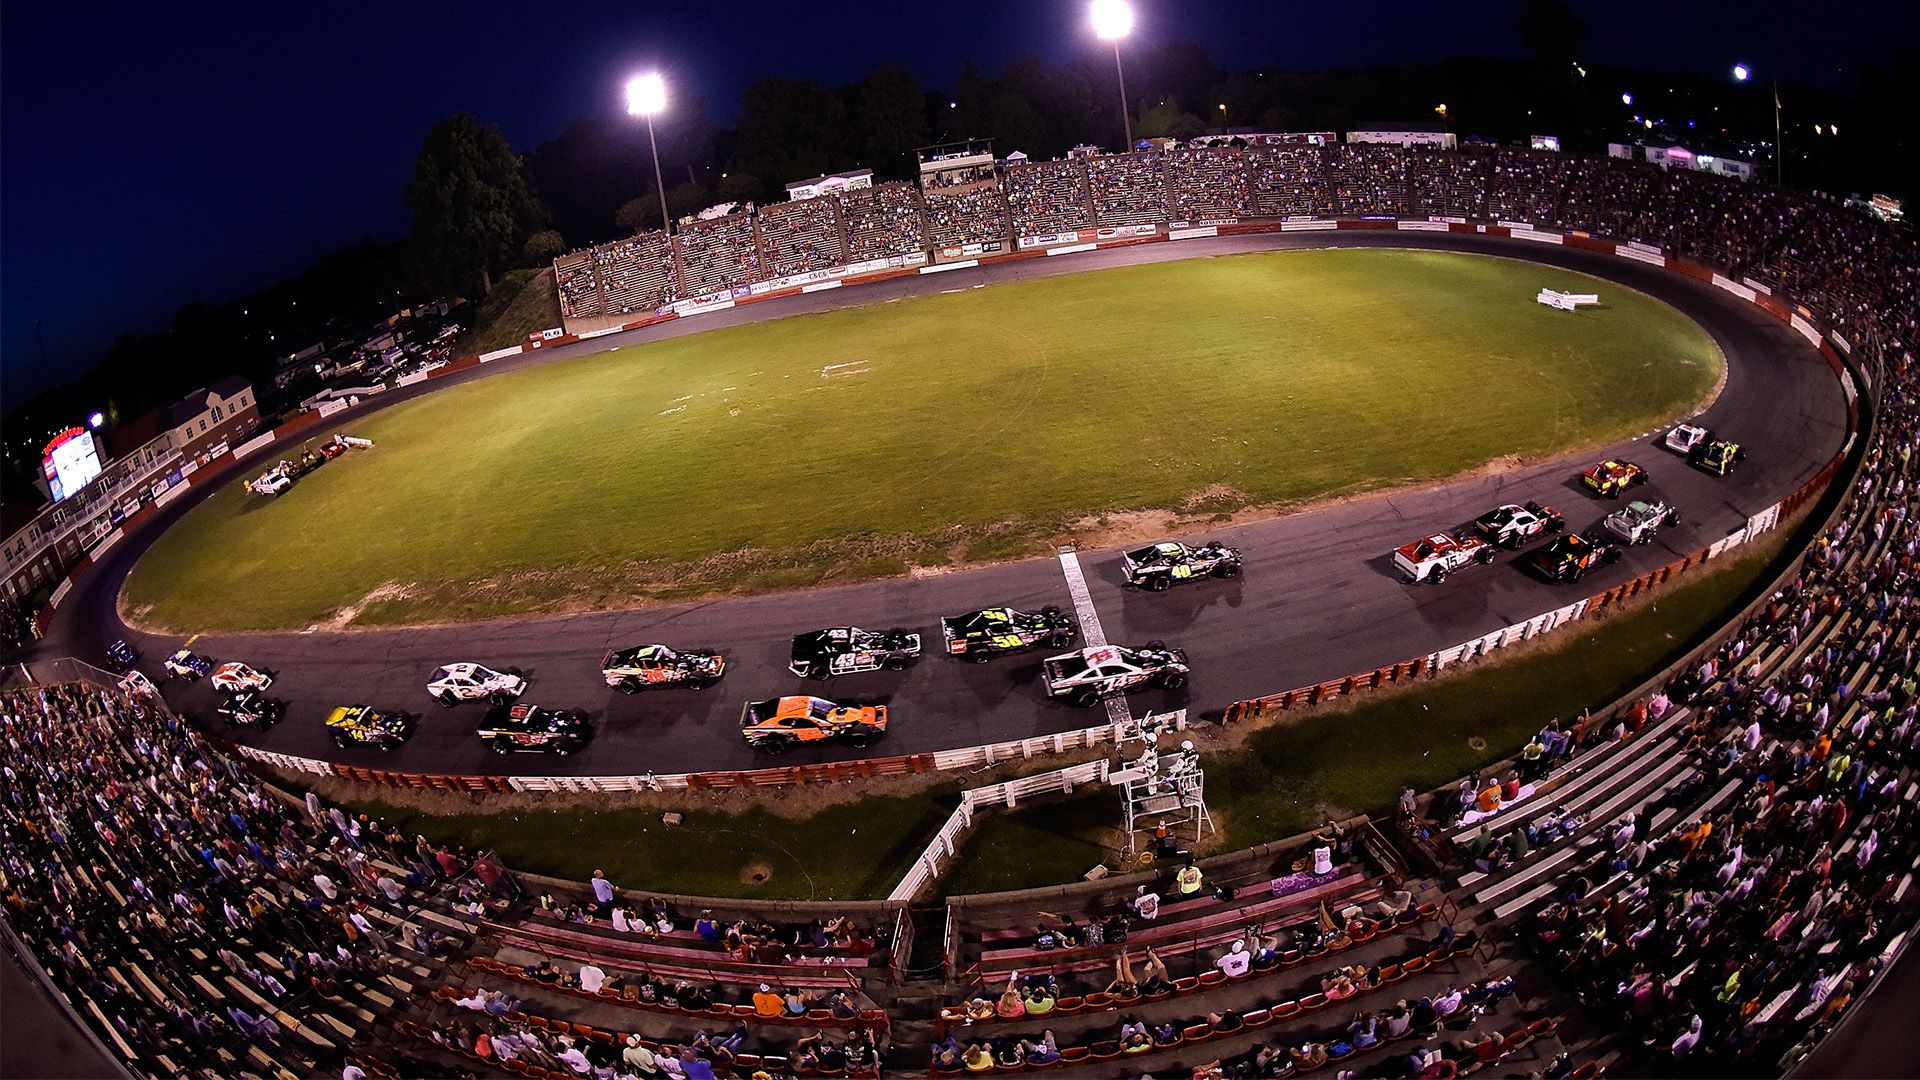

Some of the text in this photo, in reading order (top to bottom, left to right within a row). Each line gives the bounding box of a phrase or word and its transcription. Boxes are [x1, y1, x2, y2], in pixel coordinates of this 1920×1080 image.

[43, 426, 84, 456] BOWMAN GRAY
[1446, 556, 1458, 572] 15
[1172, 565, 1192, 578] 40
[828, 629, 849, 639] 43
[992, 635, 1023, 648] 58
[835, 652, 856, 667] 43
[456, 664, 468, 673] 2
[1103, 674, 1128, 692] 74
[460, 687, 476, 698] 2
[351, 729, 364, 740] 14
